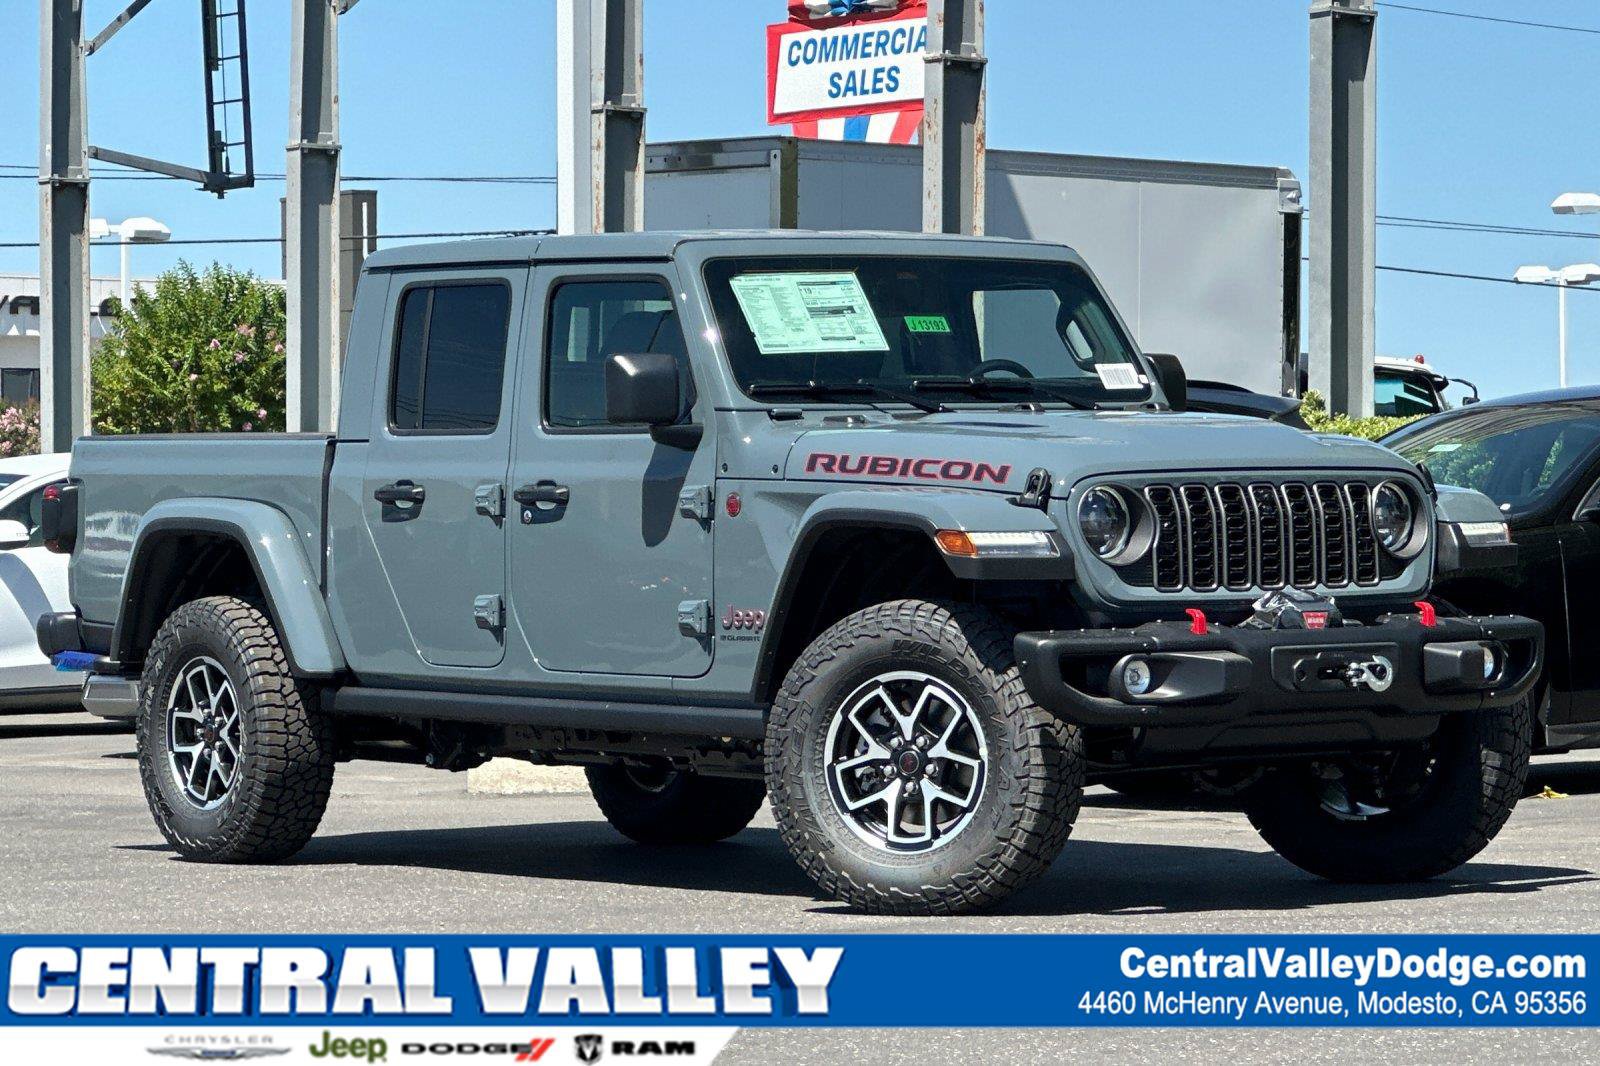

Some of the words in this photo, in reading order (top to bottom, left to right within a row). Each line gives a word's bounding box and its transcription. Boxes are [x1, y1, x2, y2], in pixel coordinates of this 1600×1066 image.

[787, 25, 928, 67] COMMERCIA
[827, 65, 900, 98] SALES
[805, 453, 1011, 484] RUBICON
[722, 604, 765, 634] Jeep
